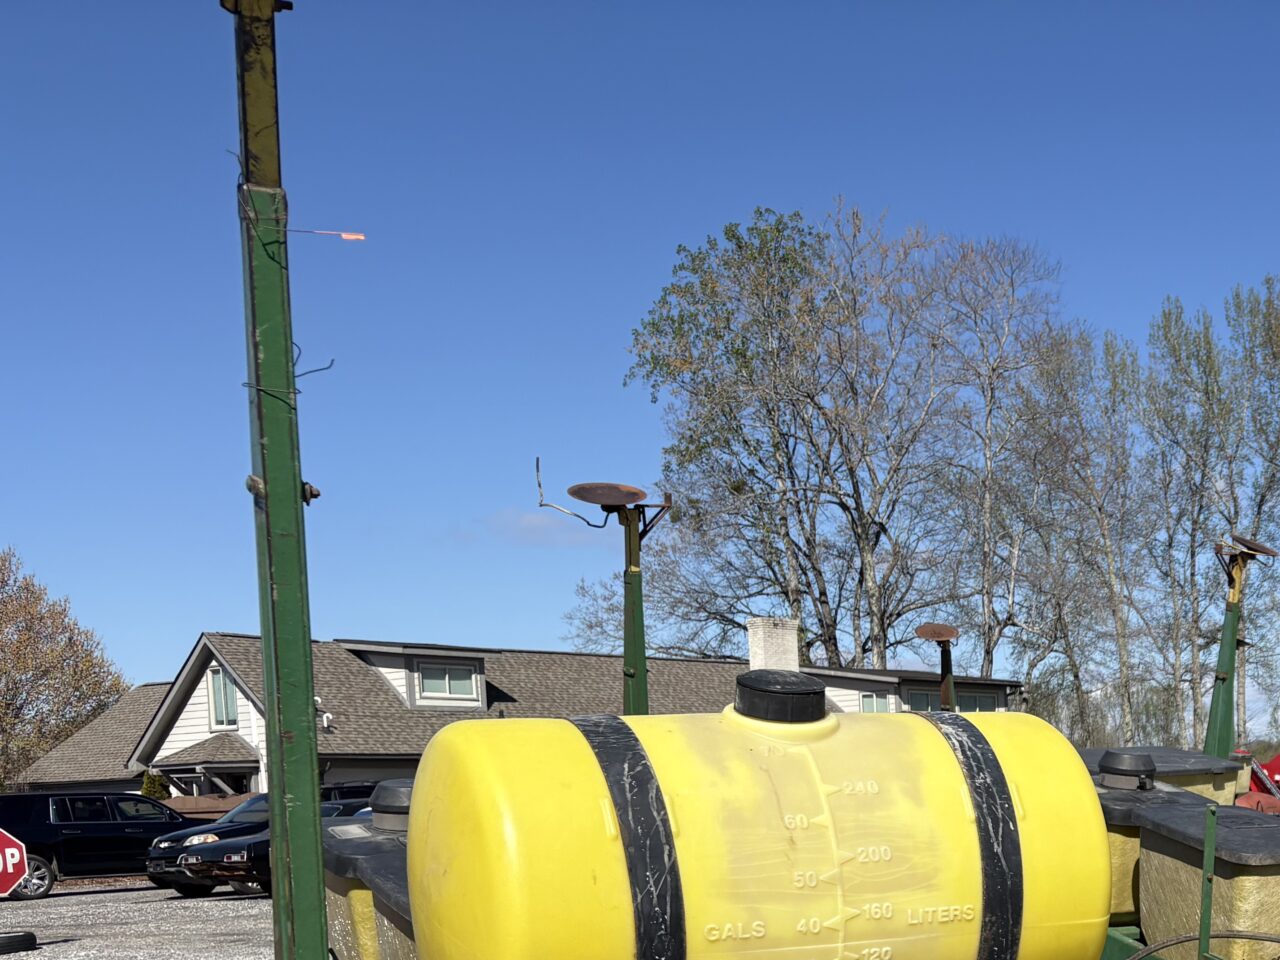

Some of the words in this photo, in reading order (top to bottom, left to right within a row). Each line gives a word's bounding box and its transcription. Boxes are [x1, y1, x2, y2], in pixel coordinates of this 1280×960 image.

[843, 780, 880, 795] 240
[784, 813, 809, 830] 60
[857, 846, 893, 863] 200
[794, 871, 819, 888] 50
[861, 903, 893, 920] 160
[907, 905, 976, 925] LITERS
[704, 921, 767, 942] GALS
[796, 917, 821, 934] 40
